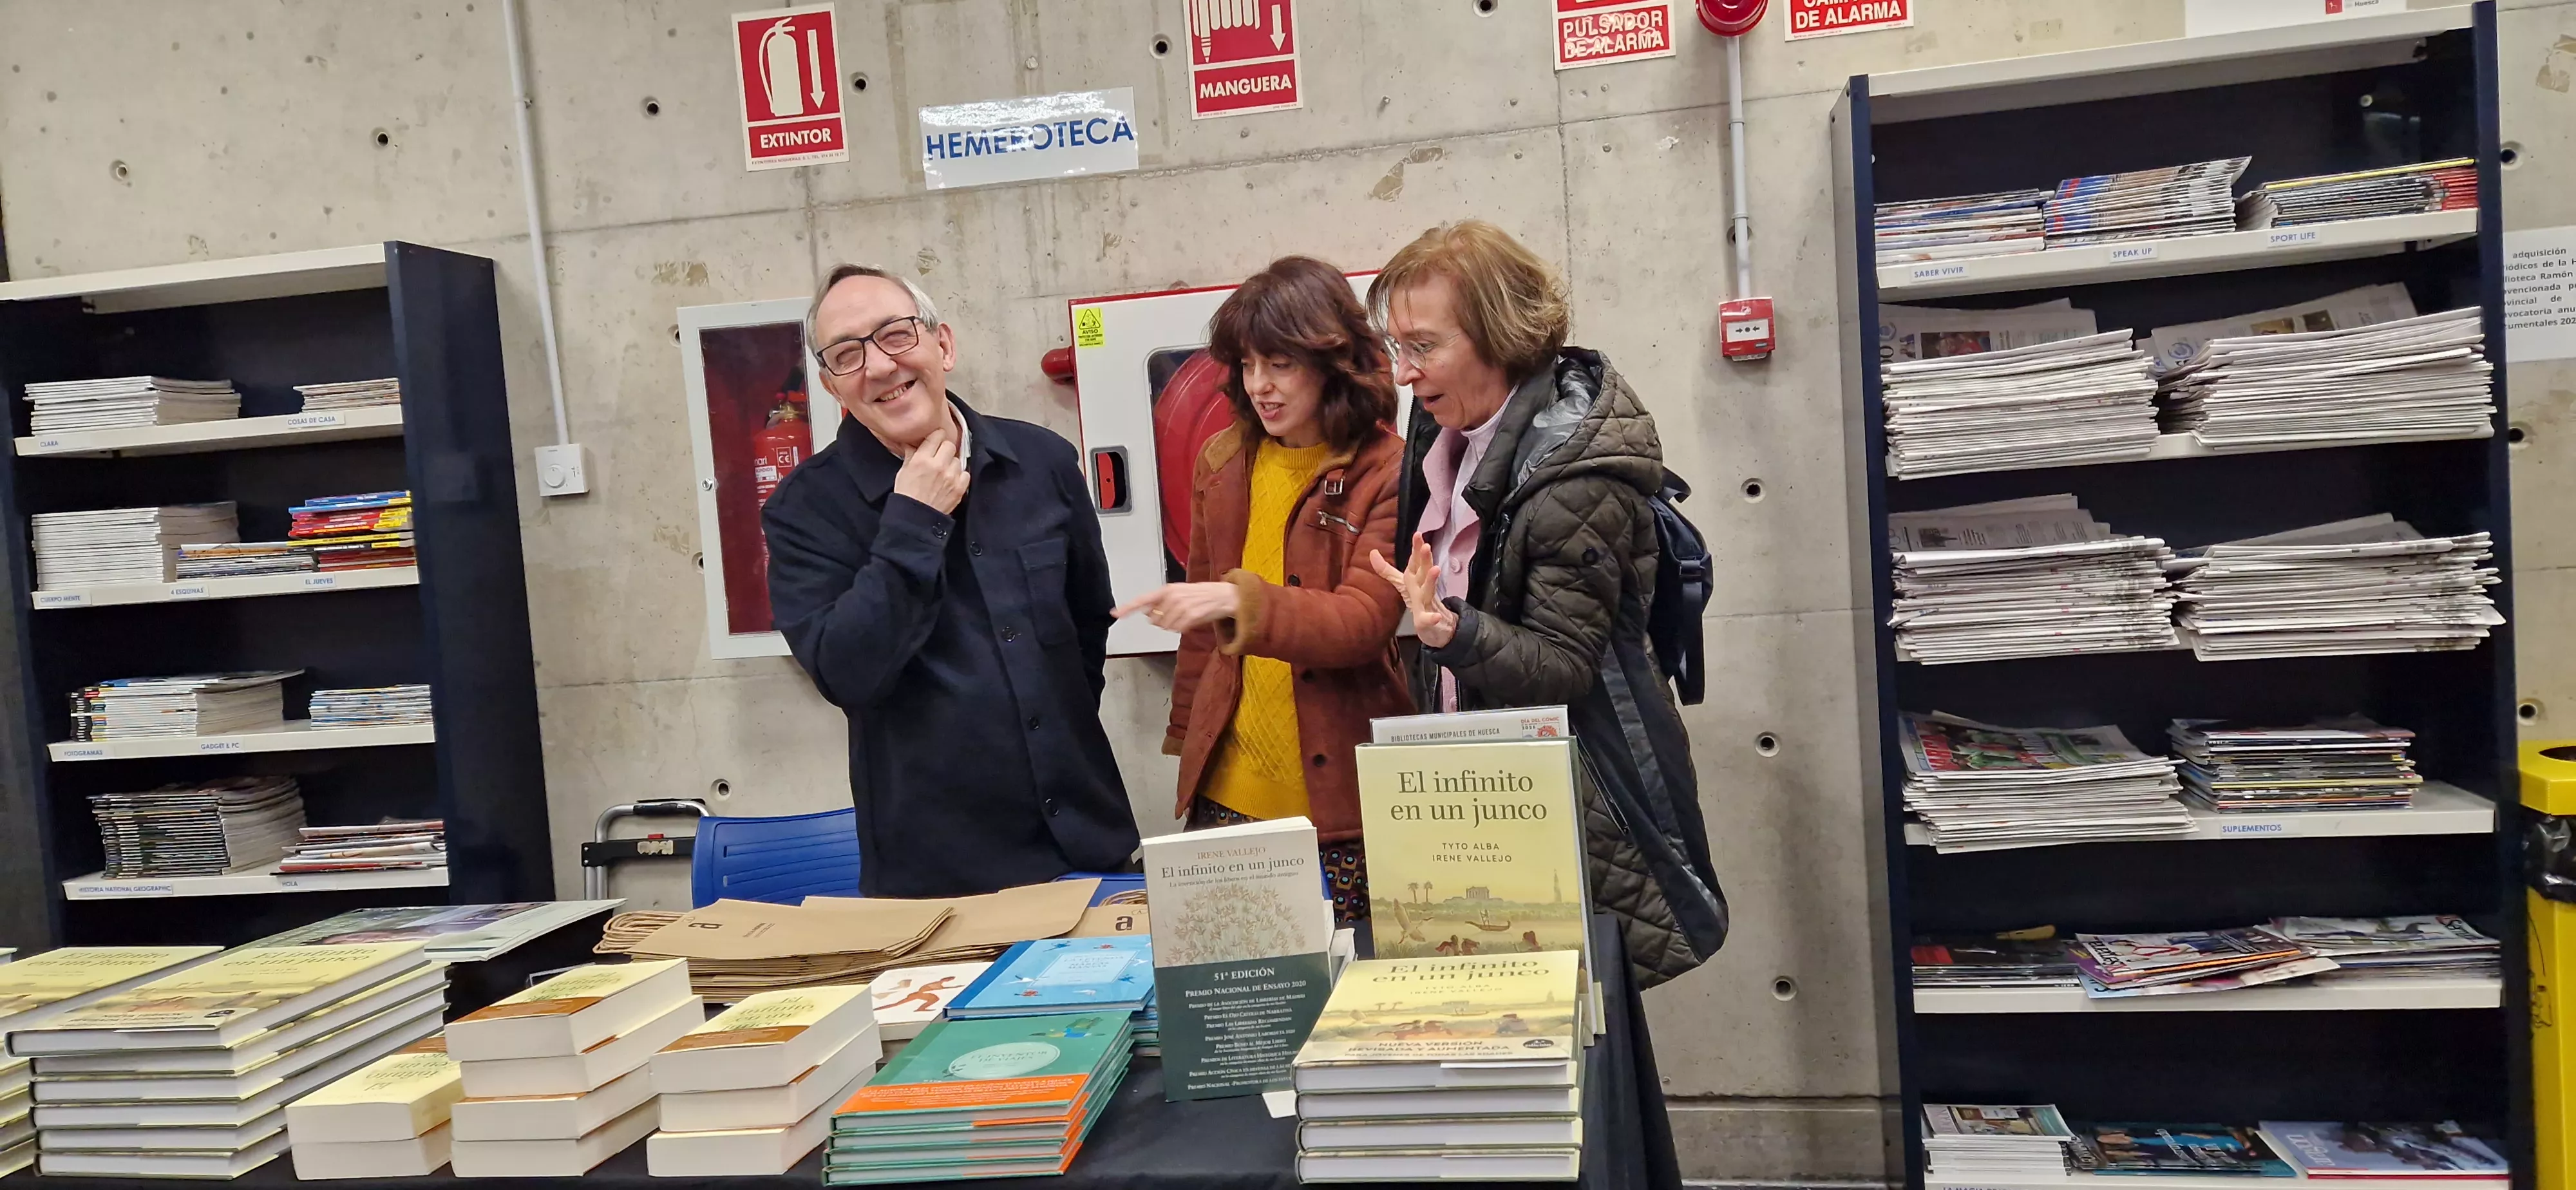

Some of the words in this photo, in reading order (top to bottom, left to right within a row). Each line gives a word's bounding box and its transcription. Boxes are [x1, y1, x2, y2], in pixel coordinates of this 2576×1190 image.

[1795, 9, 1821, 30] DE
[1824, 1, 1902, 25] ALARMA
[1563, 10, 1663, 39] PULSADOR
[1564, 40, 1587, 59] DE
[1592, 30, 1664, 55] ALARMA
[1200, 74, 1292, 99] MANGUERA
[760, 128, 832, 149] EXTINTOR
[926, 115, 1135, 160] HEMEROTECA
[2271, 233, 2298, 243] SPORT
[2300, 232, 2316, 240] LIFE
[2112, 249, 2139, 258] SPEAK
[2141, 247, 2153, 256] UP
[2513, 248, 2566, 259] adquisición
[1914, 268, 1940, 279] SABER
[1942, 266, 1964, 276] VIVIR
[2505, 262, 2538, 271] iódicos
[2505, 274, 2536, 283] lioteca
[2541, 271, 2573, 279] Ramón
[2505, 308, 2552, 317] vocatoria
[2561, 317, 2576, 325] 202
[1391, 733, 1428, 742] BIBLIOTECAS
[1429, 731, 1467, 739] MUNICIPALES
[1397, 771, 1427, 793] El
[1433, 770, 1534, 793] infinito
[1390, 804, 1423, 820] en
[1429, 804, 1466, 820] un
[1472, 798, 1548, 828] junco
[2222, 823, 2282, 833] SUPLEMENTOS
[1197, 851, 1226, 860] IRENE
[1227, 847, 1267, 857] VALLEJO
[1162, 867, 1175, 878] El
[1179, 864, 1226, 876] infinito
[1229, 863, 1244, 873] en
[1248, 860, 1265, 871] un
[1267, 857, 1305, 872] junco
[1115, 916, 1133, 931] a
[285, 949, 378, 958] infinito
[88, 959, 157, 967] junco
[293, 956, 370, 965] junco
[1388, 965, 1418, 974] El
[1430, 960, 1539, 971] infinito
[1214, 971, 1229, 981] 51ª
[1231, 967, 1275, 979] EDICIÓN
[1466, 969, 1549, 981] junco
[549, 978, 621, 988] infinito
[1185, 989, 1213, 997] PREMIO
[1214, 986, 1251, 995] NACIONAL
[1263, 981, 1291, 990] ENSAYO
[1291, 979, 1307, 988] 2020
[739, 1004, 815, 1015] infinito
